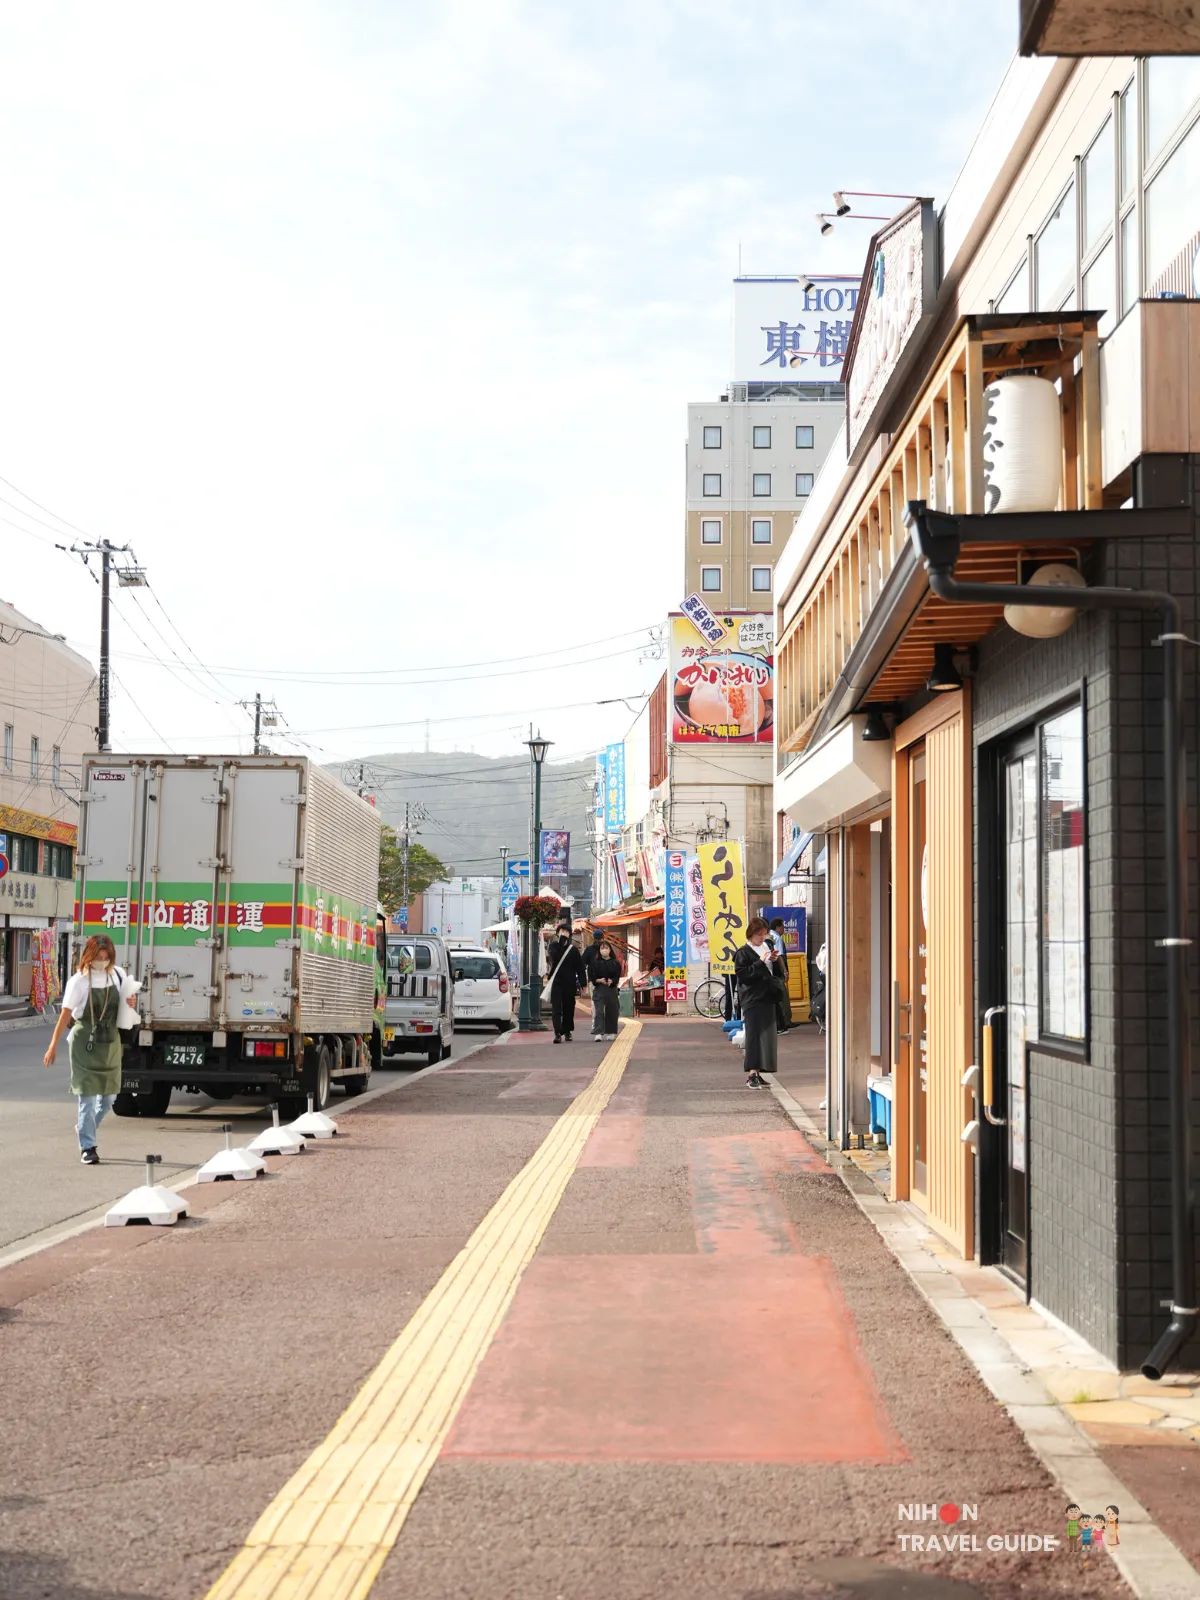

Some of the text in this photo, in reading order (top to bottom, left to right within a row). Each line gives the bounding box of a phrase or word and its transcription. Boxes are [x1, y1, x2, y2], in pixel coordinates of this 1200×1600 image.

[741, 622, 764, 632] 大好き
[678, 724, 740, 736] はこだて朝市
[101, 897, 264, 933] 福山通運
[667, 990, 686, 1000] 入口
[173, 1053, 203, 1065] 24-76
